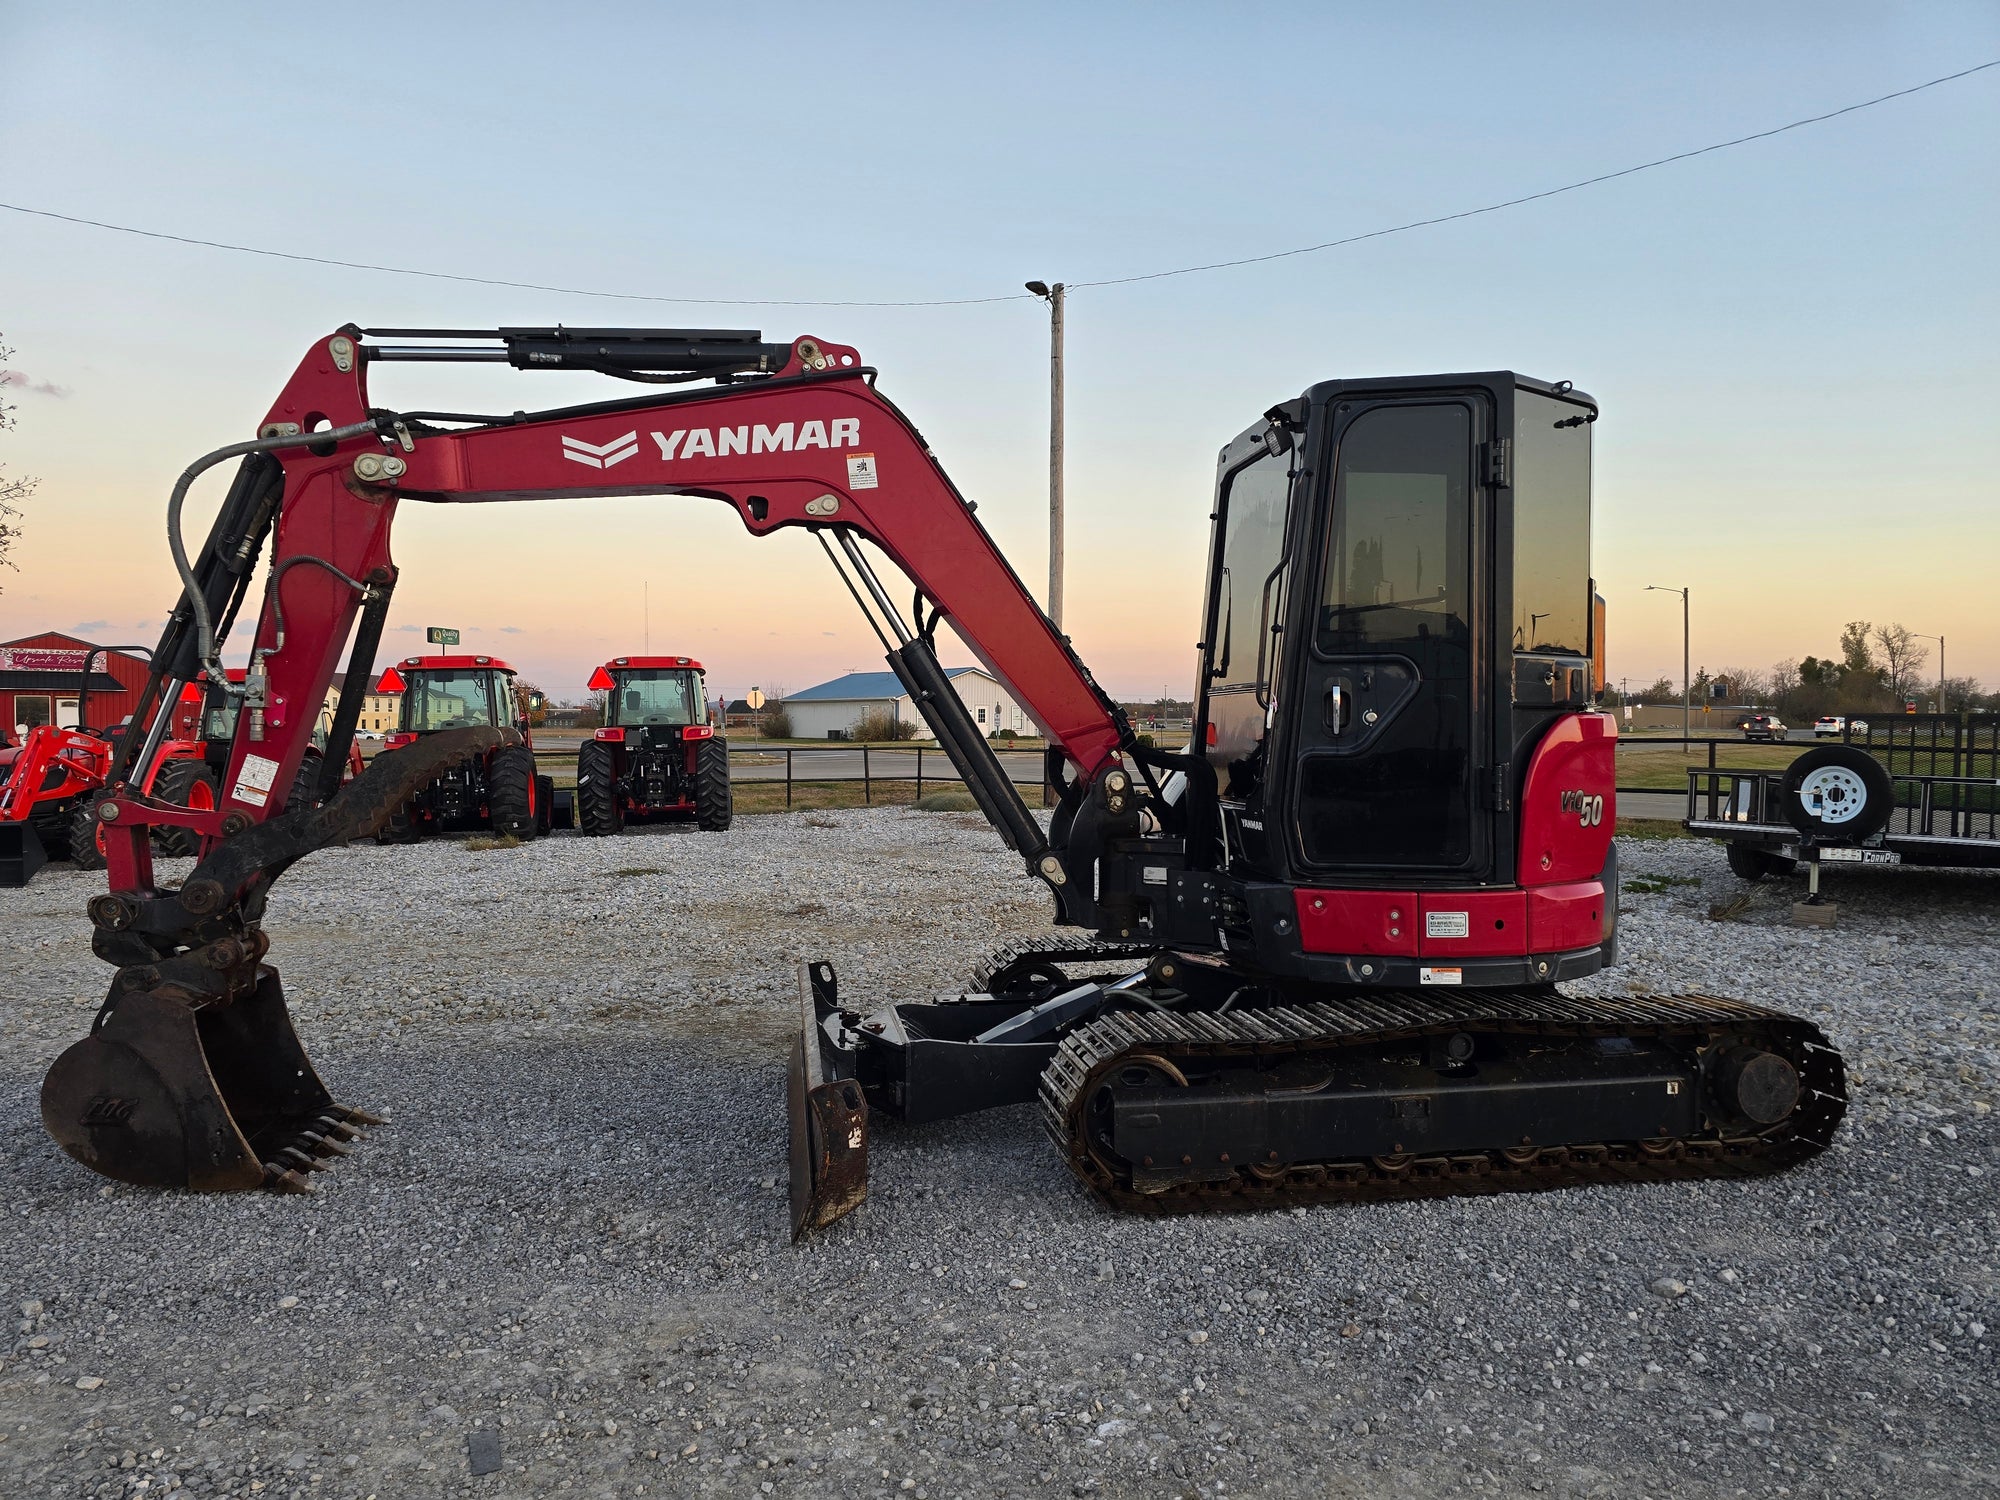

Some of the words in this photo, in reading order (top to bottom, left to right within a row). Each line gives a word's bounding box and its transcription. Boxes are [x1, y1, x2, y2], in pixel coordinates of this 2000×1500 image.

[650, 418, 860, 460] YANMAR
[442, 629, 458, 639] Quality
[15, 655, 54, 664] Upscale
[1240, 818, 1264, 831] YANMAR
